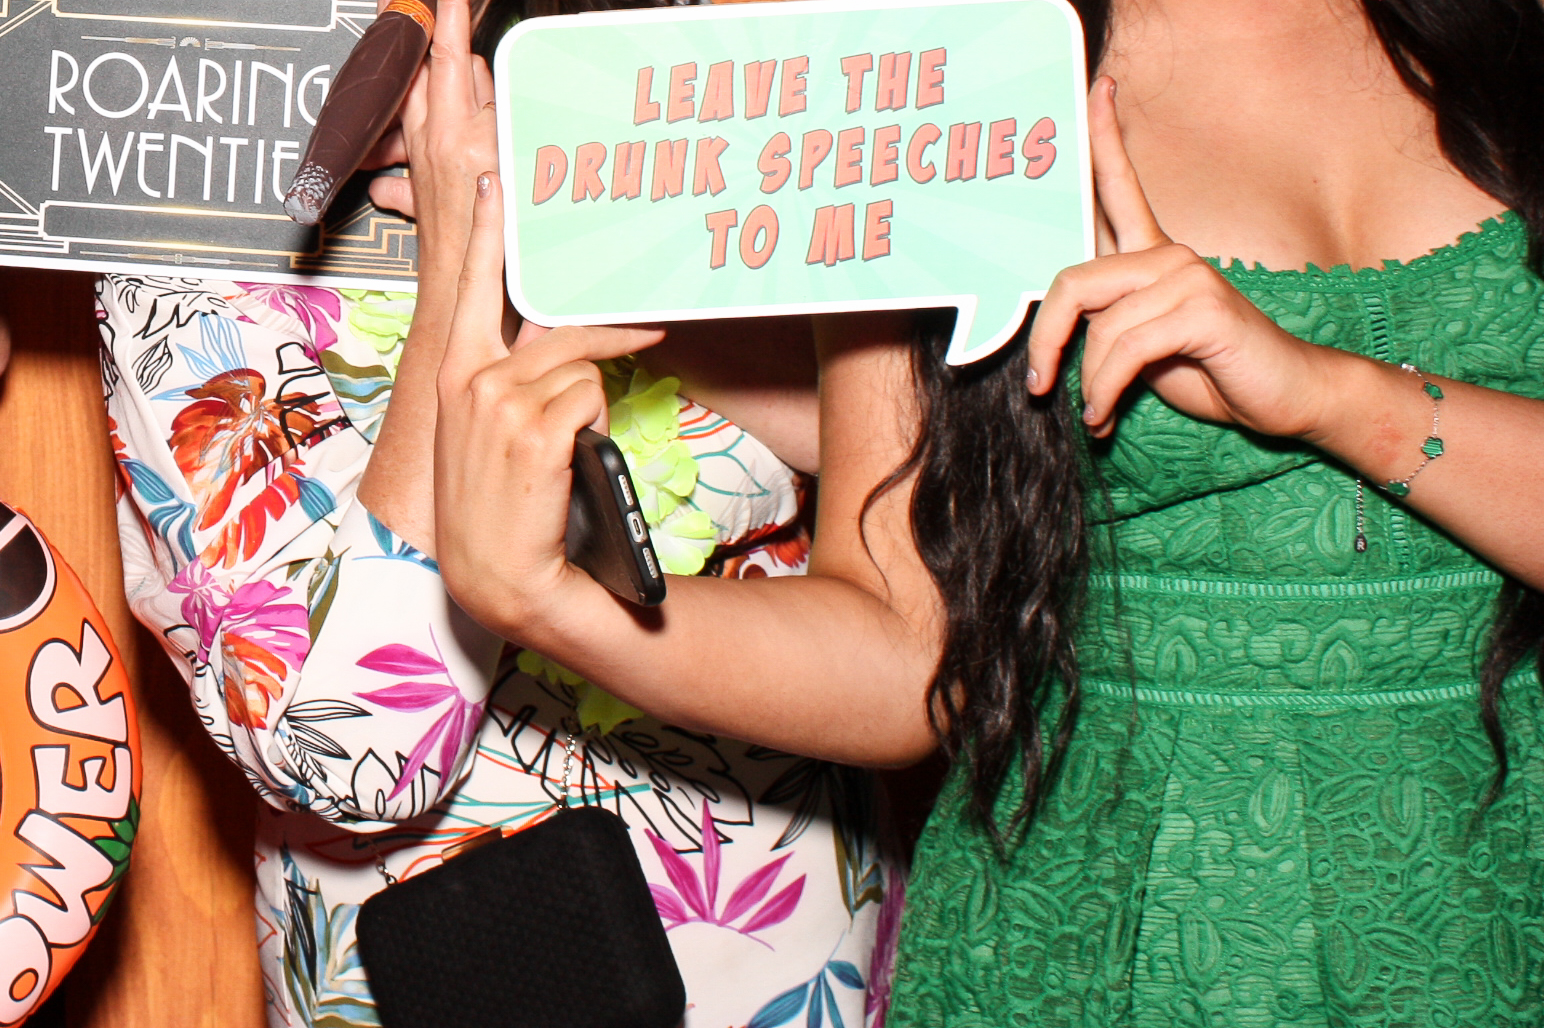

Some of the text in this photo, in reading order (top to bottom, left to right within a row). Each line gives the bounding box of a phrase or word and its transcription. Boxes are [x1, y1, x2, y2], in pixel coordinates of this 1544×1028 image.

[48, 49, 331, 128] ROARING
[633, 47, 947, 125] LEAVE THE
[44, 126, 300, 204] TWENTIE
[531, 117, 1057, 206] DRUNK SPEECHES
[705, 199, 894, 270] TO ME
